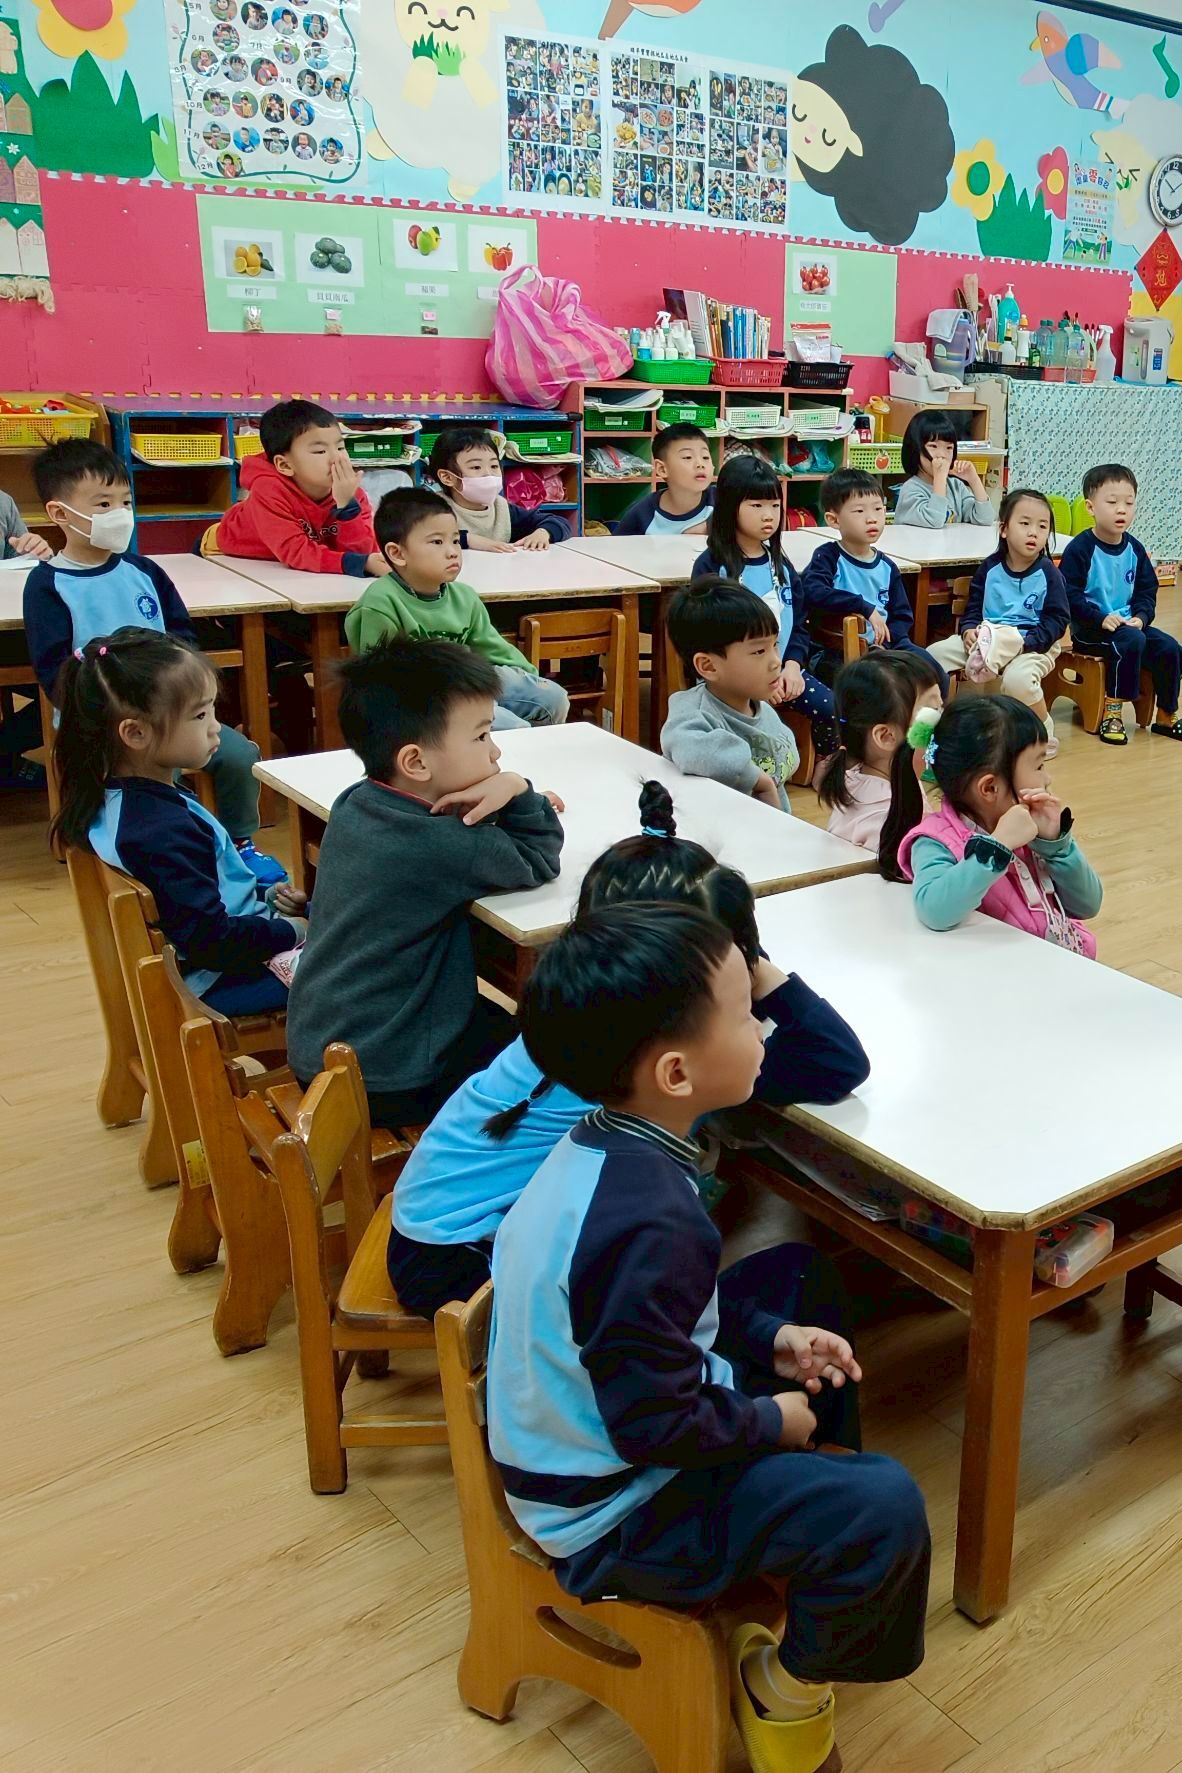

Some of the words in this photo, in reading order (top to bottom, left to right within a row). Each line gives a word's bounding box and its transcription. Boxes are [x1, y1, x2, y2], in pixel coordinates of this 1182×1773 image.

[191, 34, 205, 43] 6月
[280, 76, 292, 85] 9月
[186, 101, 203, 109] 10月
[1173, 161, 1180, 170] 12
[1167, 211, 1172, 219] 6
[1175, 209, 1180, 217] 5
